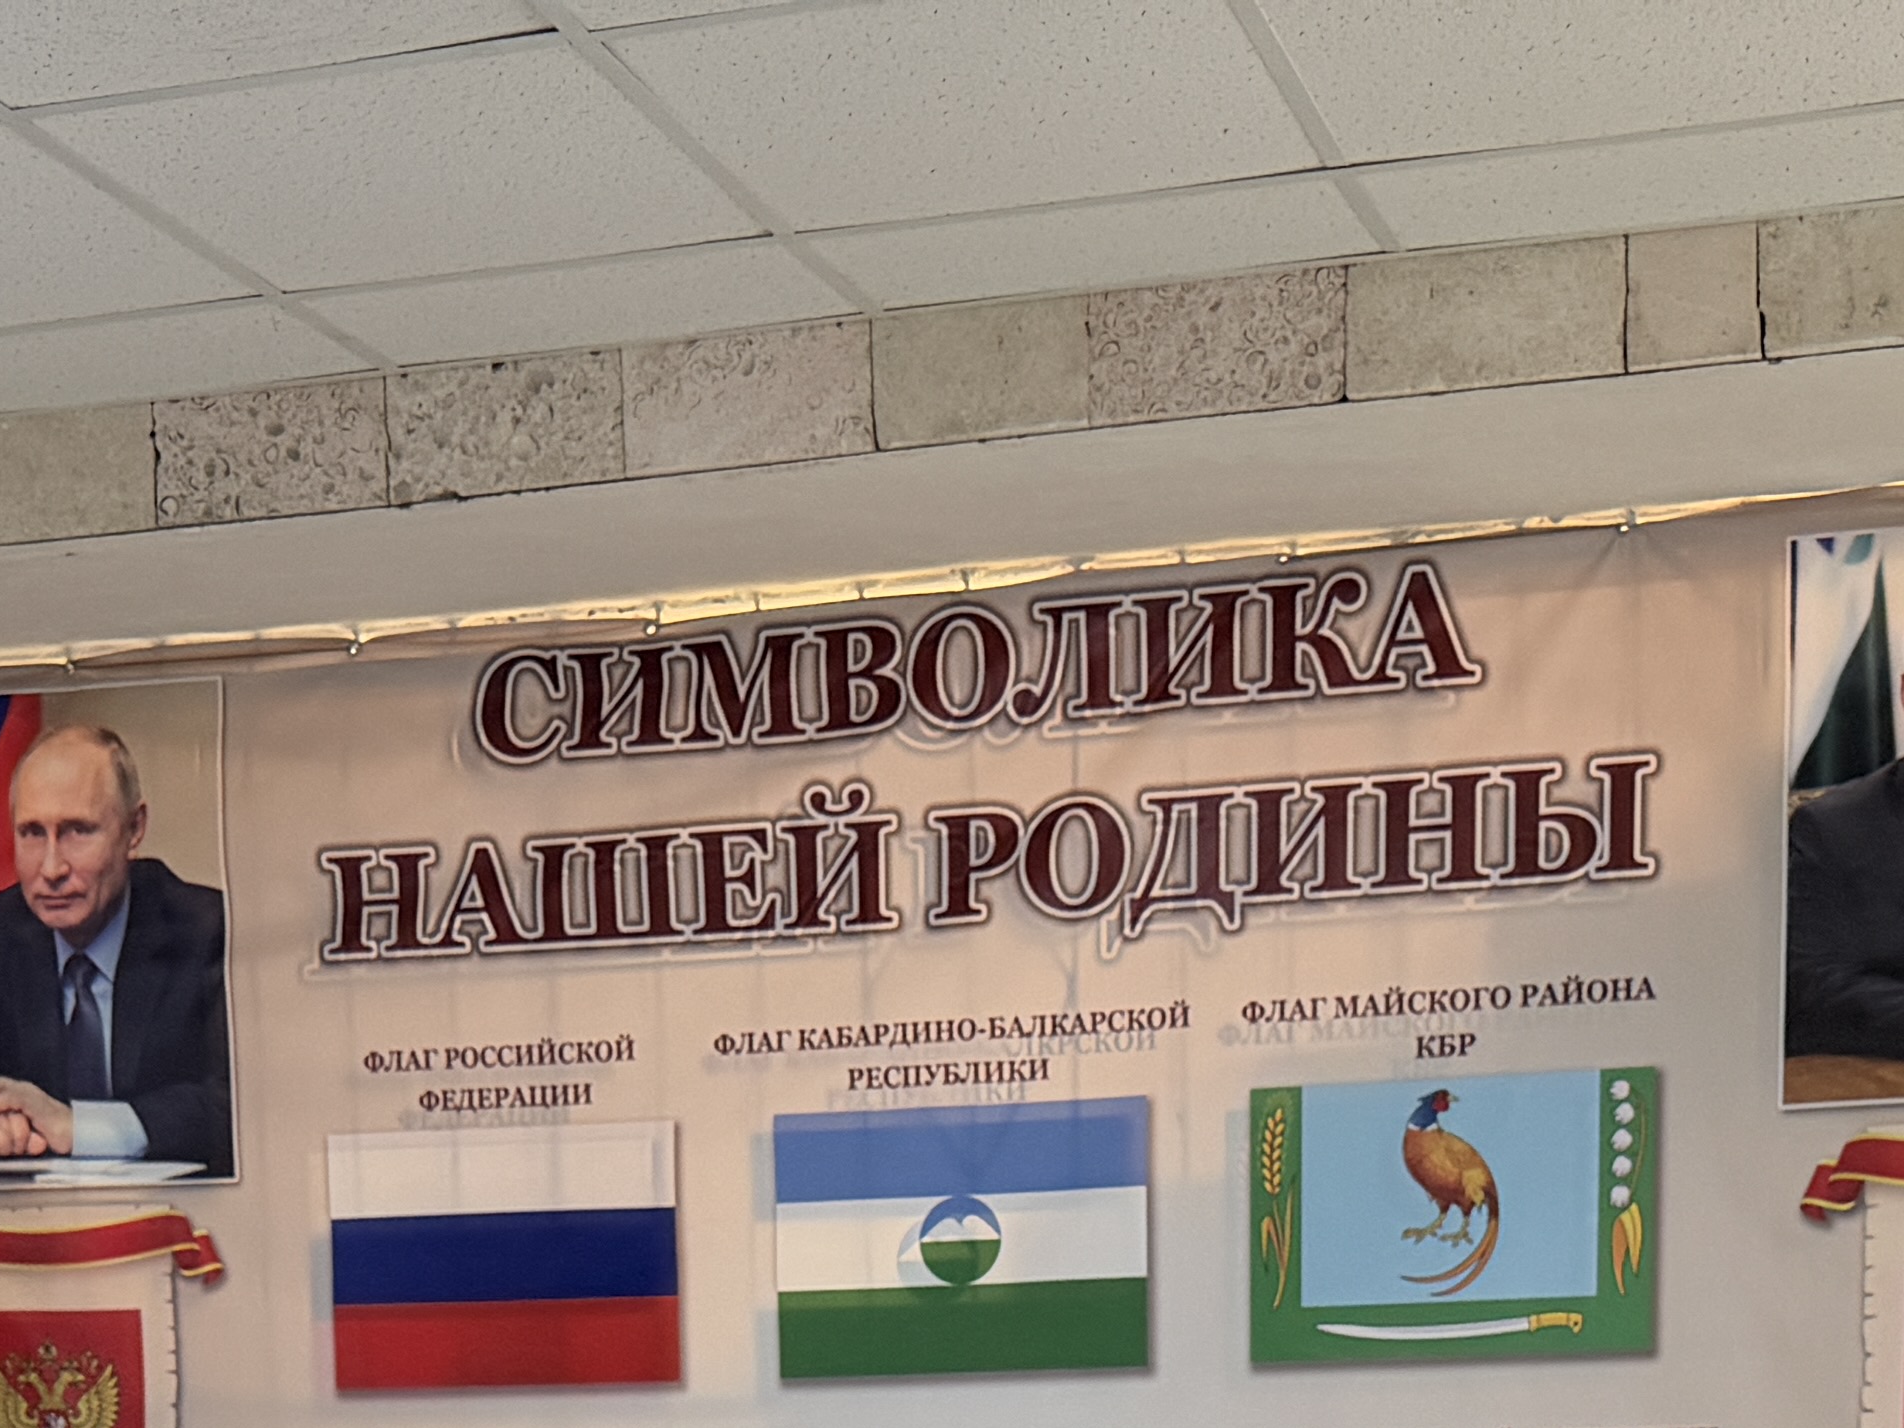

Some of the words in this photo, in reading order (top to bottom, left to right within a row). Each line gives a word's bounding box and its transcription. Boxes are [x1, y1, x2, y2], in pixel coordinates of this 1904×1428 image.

[476, 564, 1481, 762] СИМВОЛИКА
[321, 782, 899, 962] НАШЕЙ
[928, 754, 1659, 938] РОДИНЫ
[1242, 995, 1328, 1026] ФЛАГ
[1333, 984, 1512, 1021] МАЙСКОГО
[1519, 973, 1657, 1008] РАЙОНА
[713, 1028, 793, 1057] ФЛАГ
[796, 999, 1192, 1053] КАБАРДИНО-БАЛКАРСКОЙ
[1415, 1031, 1477, 1061] КБР
[363, 1048, 438, 1074] ФЛАГ
[444, 1034, 636, 1071] РОССИЙСКОЙ
[847, 1057, 1050, 1091] РЕСПУБЛИКИ
[418, 1082, 594, 1113] ФЕДЕРАЦИИ
